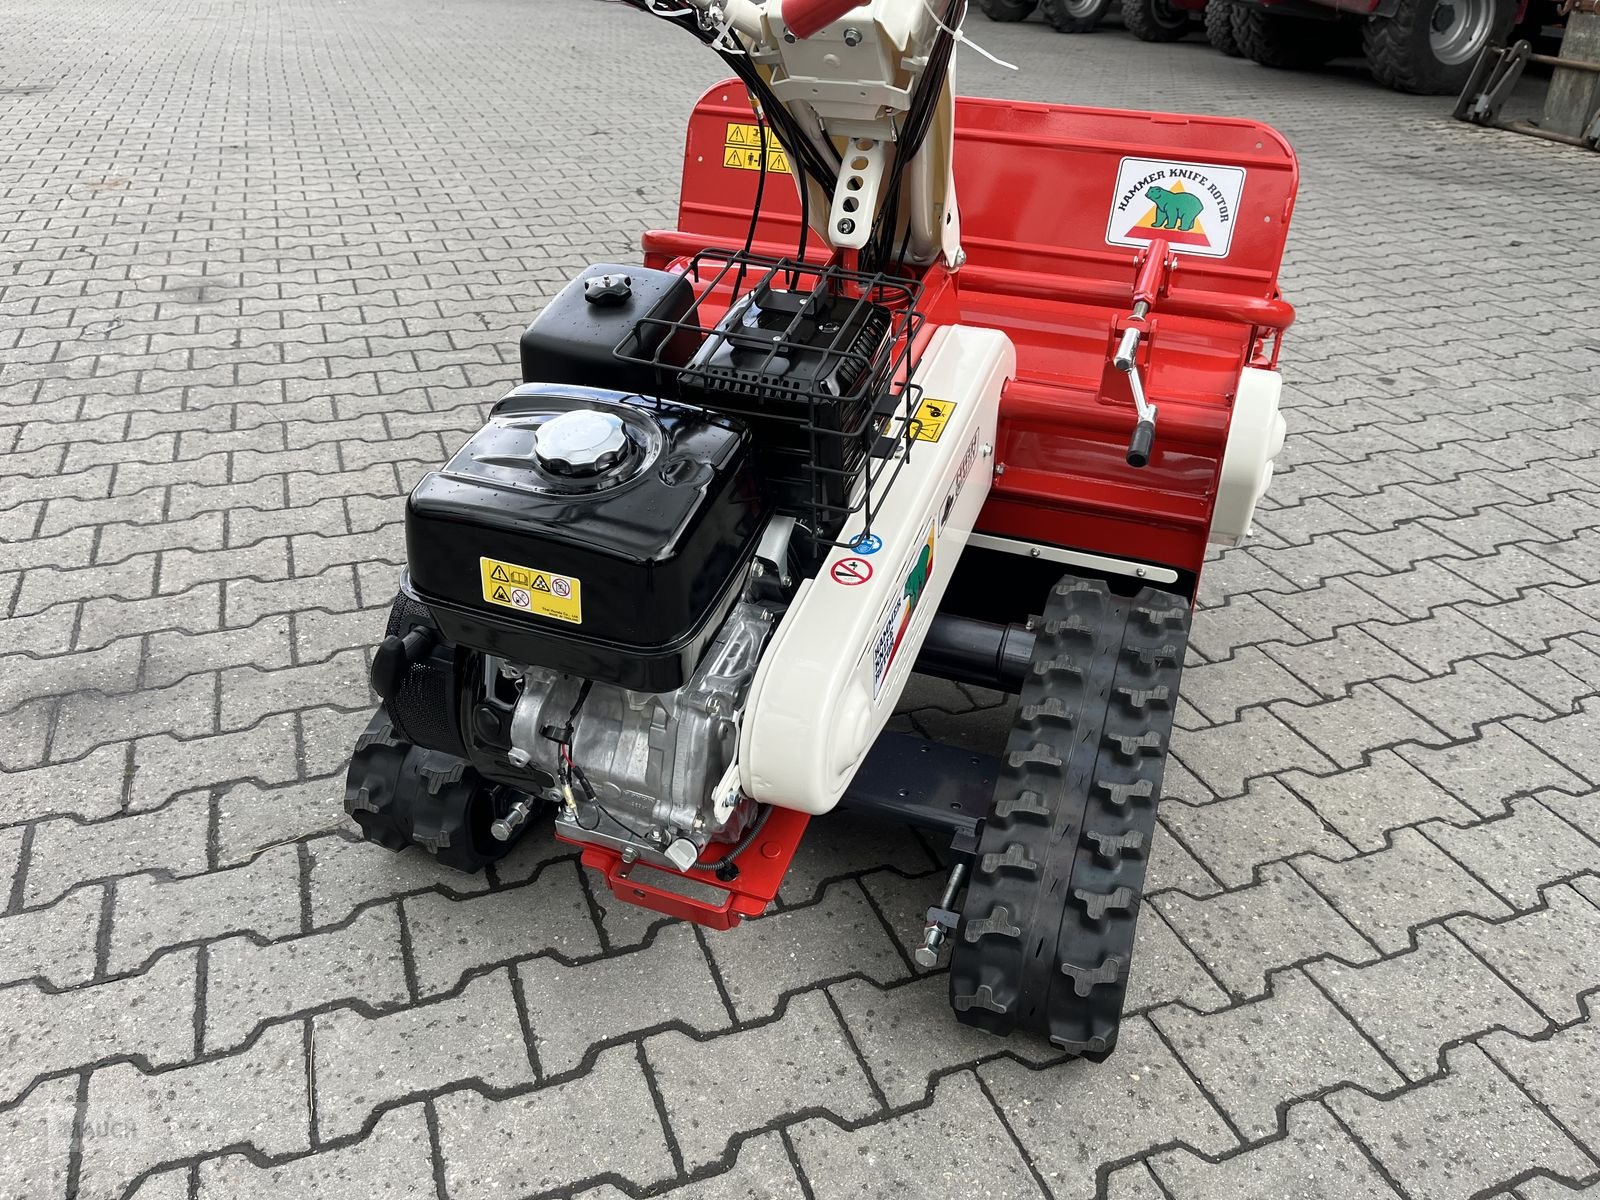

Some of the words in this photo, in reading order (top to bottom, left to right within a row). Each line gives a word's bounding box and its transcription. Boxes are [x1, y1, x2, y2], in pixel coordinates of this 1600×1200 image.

[1118, 170, 1166, 211] HAMMER
[1169, 168, 1208, 186] KNIFE
[1207, 183, 1229, 223] ROTOR
